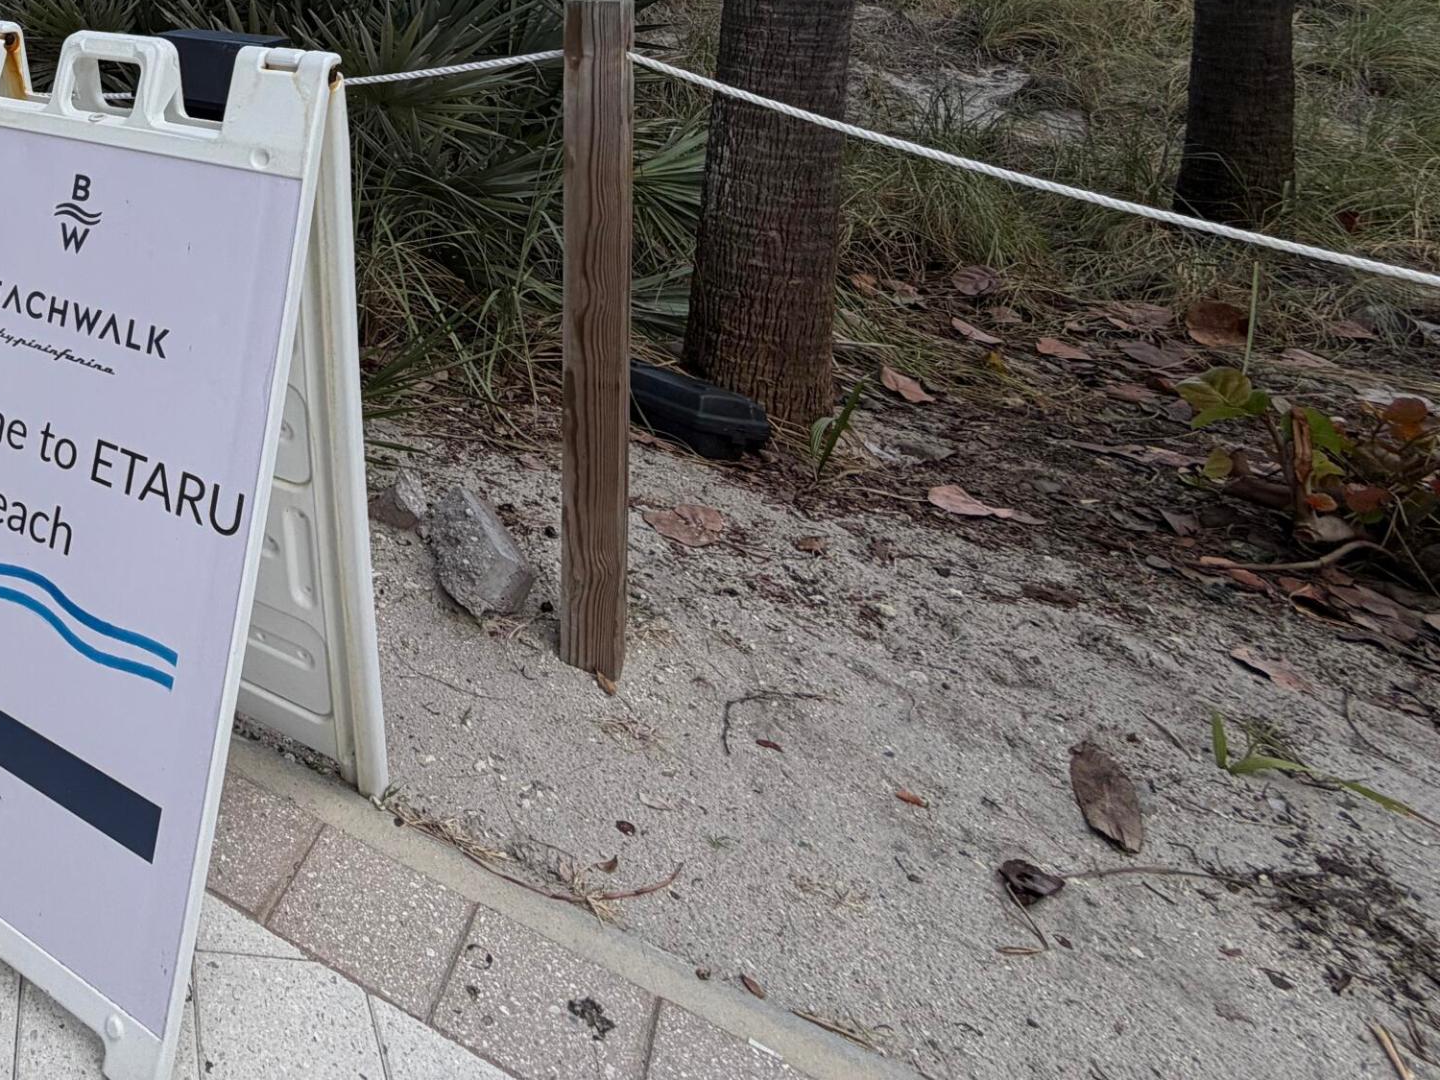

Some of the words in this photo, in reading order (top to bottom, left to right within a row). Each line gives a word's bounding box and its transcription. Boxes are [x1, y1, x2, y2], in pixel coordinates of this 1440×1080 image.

[71, 173, 92, 202] B
[61, 222, 91, 254] W
[40, 422, 77, 470] to
[90, 438, 246, 537] ETARU
